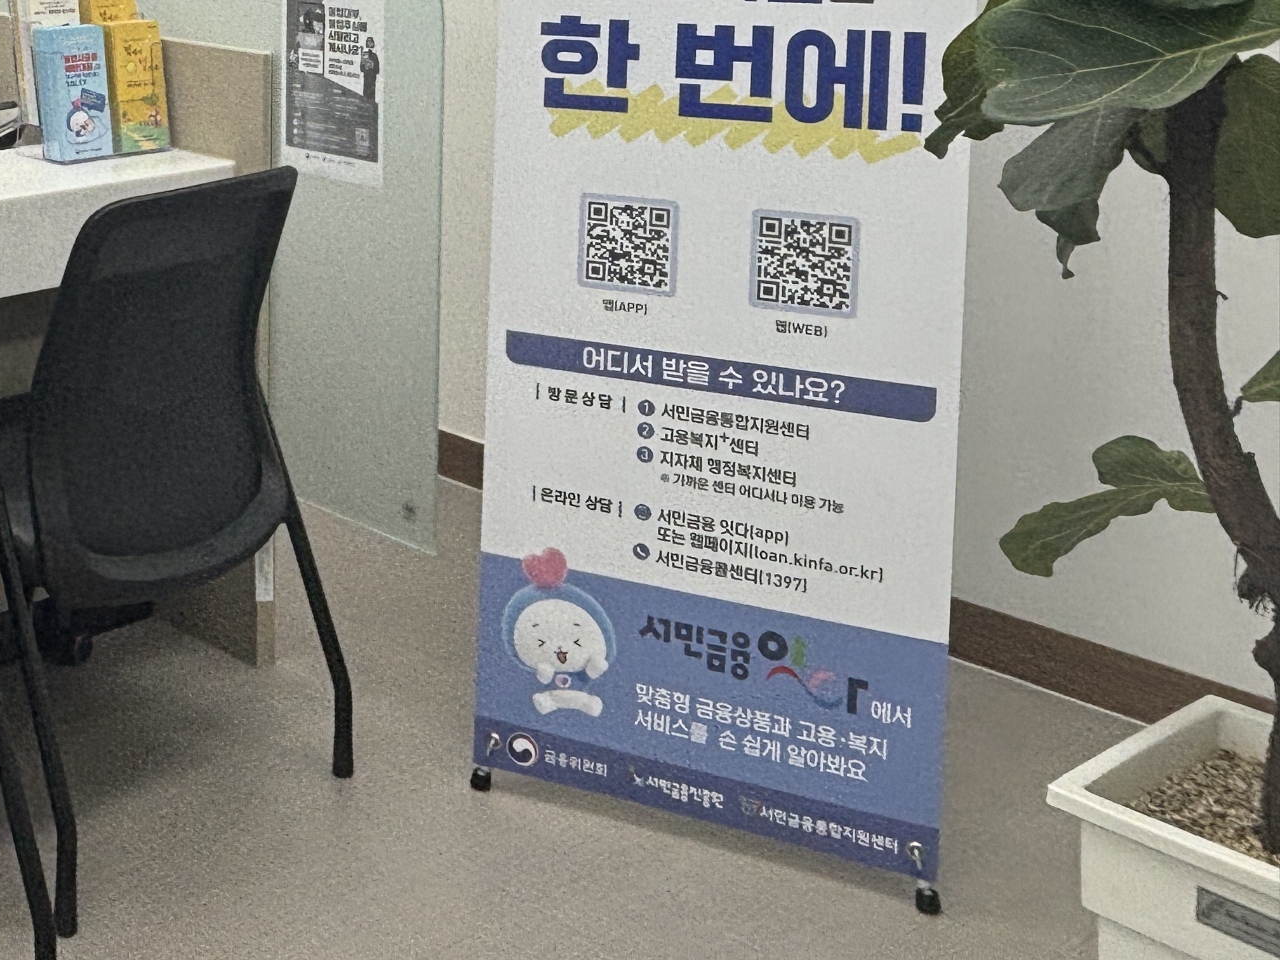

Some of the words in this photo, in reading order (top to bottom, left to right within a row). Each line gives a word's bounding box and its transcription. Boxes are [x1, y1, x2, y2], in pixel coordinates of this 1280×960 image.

[540, 14, 641, 114] 한
[674, 22, 928, 133] 번에!
[582, 346, 653, 378] 어디서
[662, 356, 710, 386] 받을
[719, 365, 744, 390] 수
[752, 369, 846, 404] 있나요?
[661, 403, 810, 441] 서민금융통합지원센터
[659, 450, 703, 472] 지자체
[707, 457, 797, 488] 행정복지센터
[540, 486, 581, 508] 온라인
[585, 495, 614, 514] 상담
[673, 473, 709, 491] 가까운
[712, 480, 736, 496] 센터
[739, 484, 788, 505] 어디서나
[791, 493, 816, 509] 이용
[819, 497, 845, 514] 가능
[656, 526, 686, 546] 또는
[657, 508, 716, 532] 서민금융
[638, 615, 751, 681] 서민금융
[635, 683, 690, 714] 맞춤형
[695, 696, 792, 738] 금융상품과
[718, 730, 739, 751] 손
[741, 734, 782, 763] 쉽게
[759, 805, 899, 854] 서민금융통합지원센터
